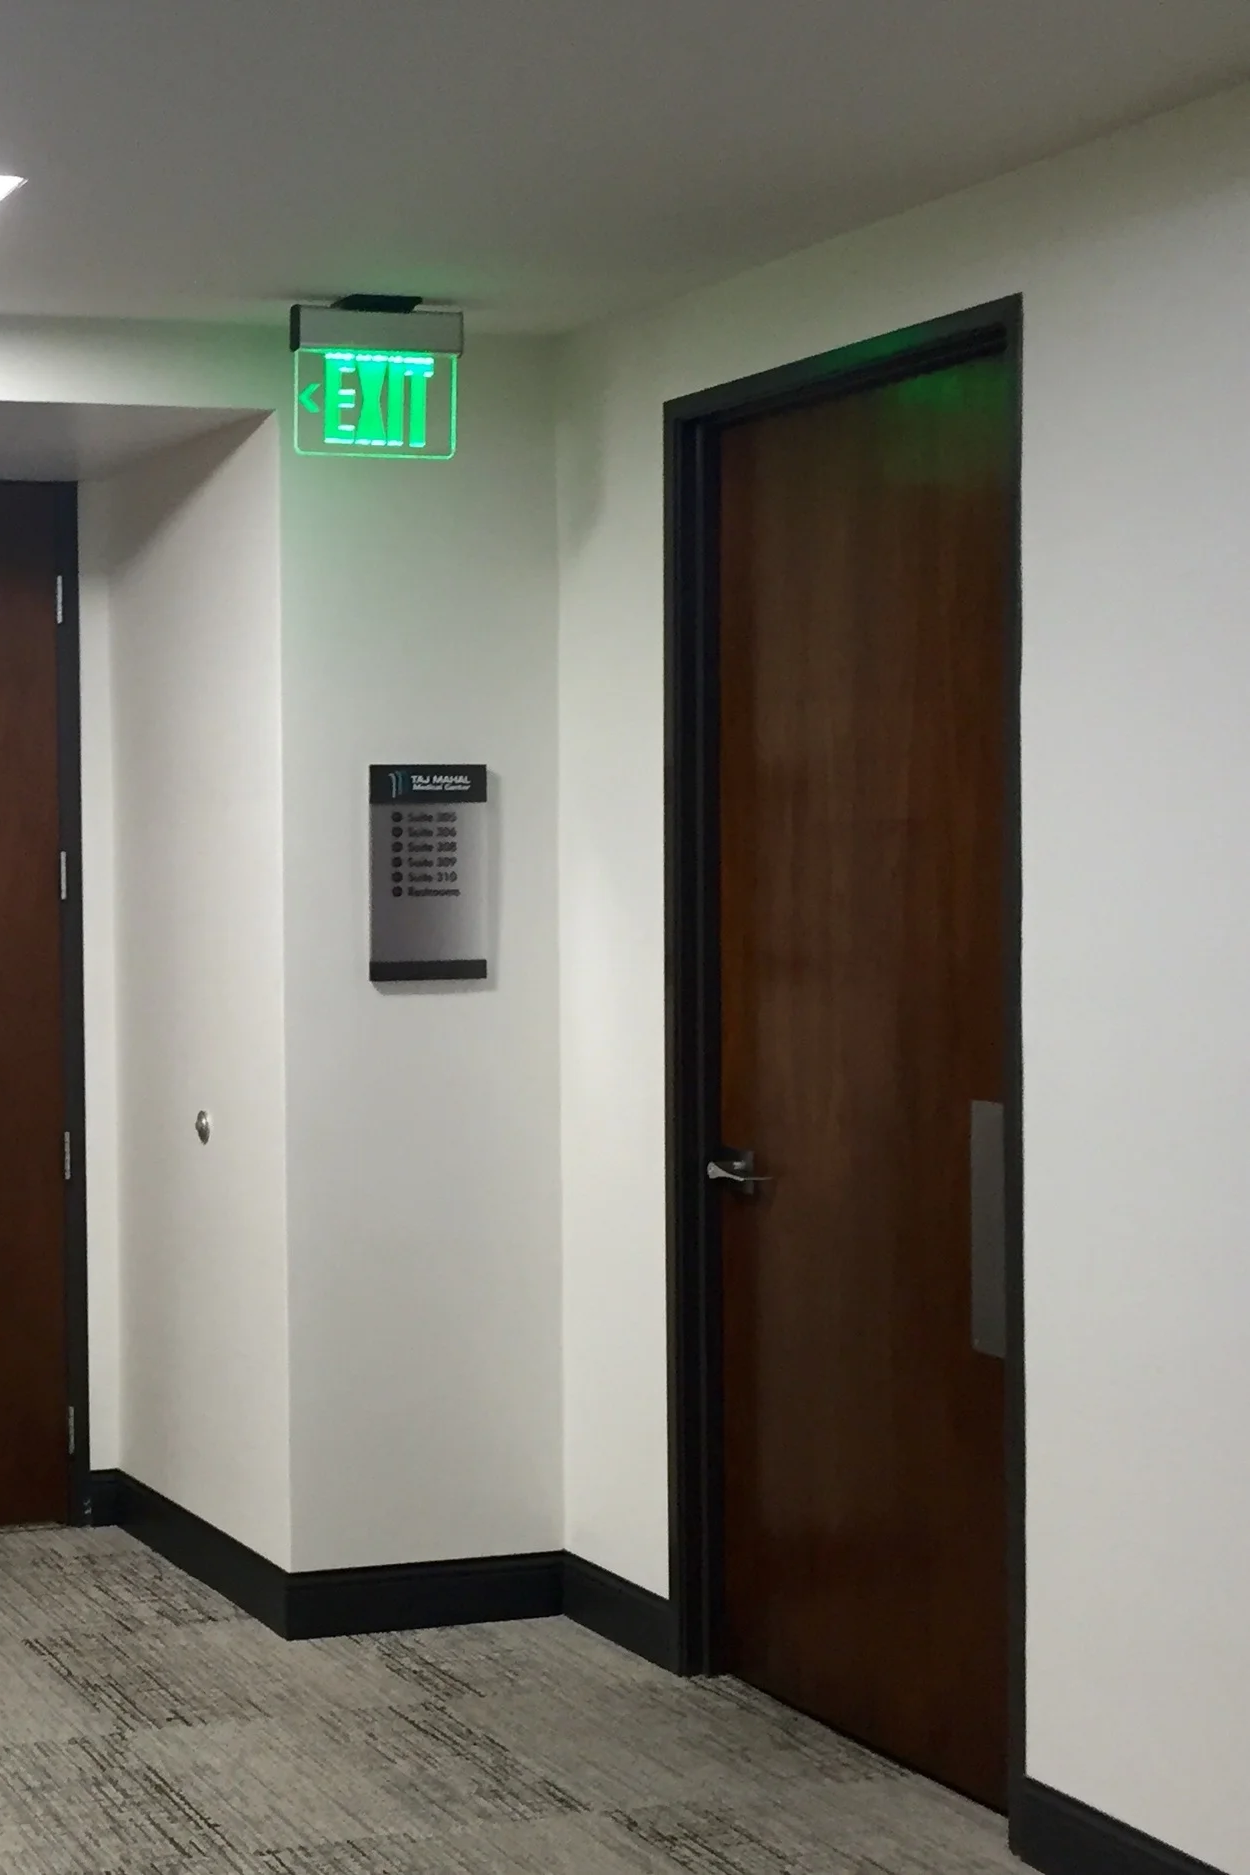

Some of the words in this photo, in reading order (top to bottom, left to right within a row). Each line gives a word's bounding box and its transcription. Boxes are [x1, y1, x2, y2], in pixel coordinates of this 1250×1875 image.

[324, 352, 435, 448] EXIT
[410, 775, 430, 784] TAJ
[432, 775, 471, 784] MAHAL
[408, 812, 434, 822] Suite
[408, 826, 434, 838] Suite
[408, 841, 434, 852] Suite
[408, 856, 434, 868] Suite
[436, 856, 458, 868] 309
[408, 872, 434, 883] Suite
[436, 872, 458, 883] 310
